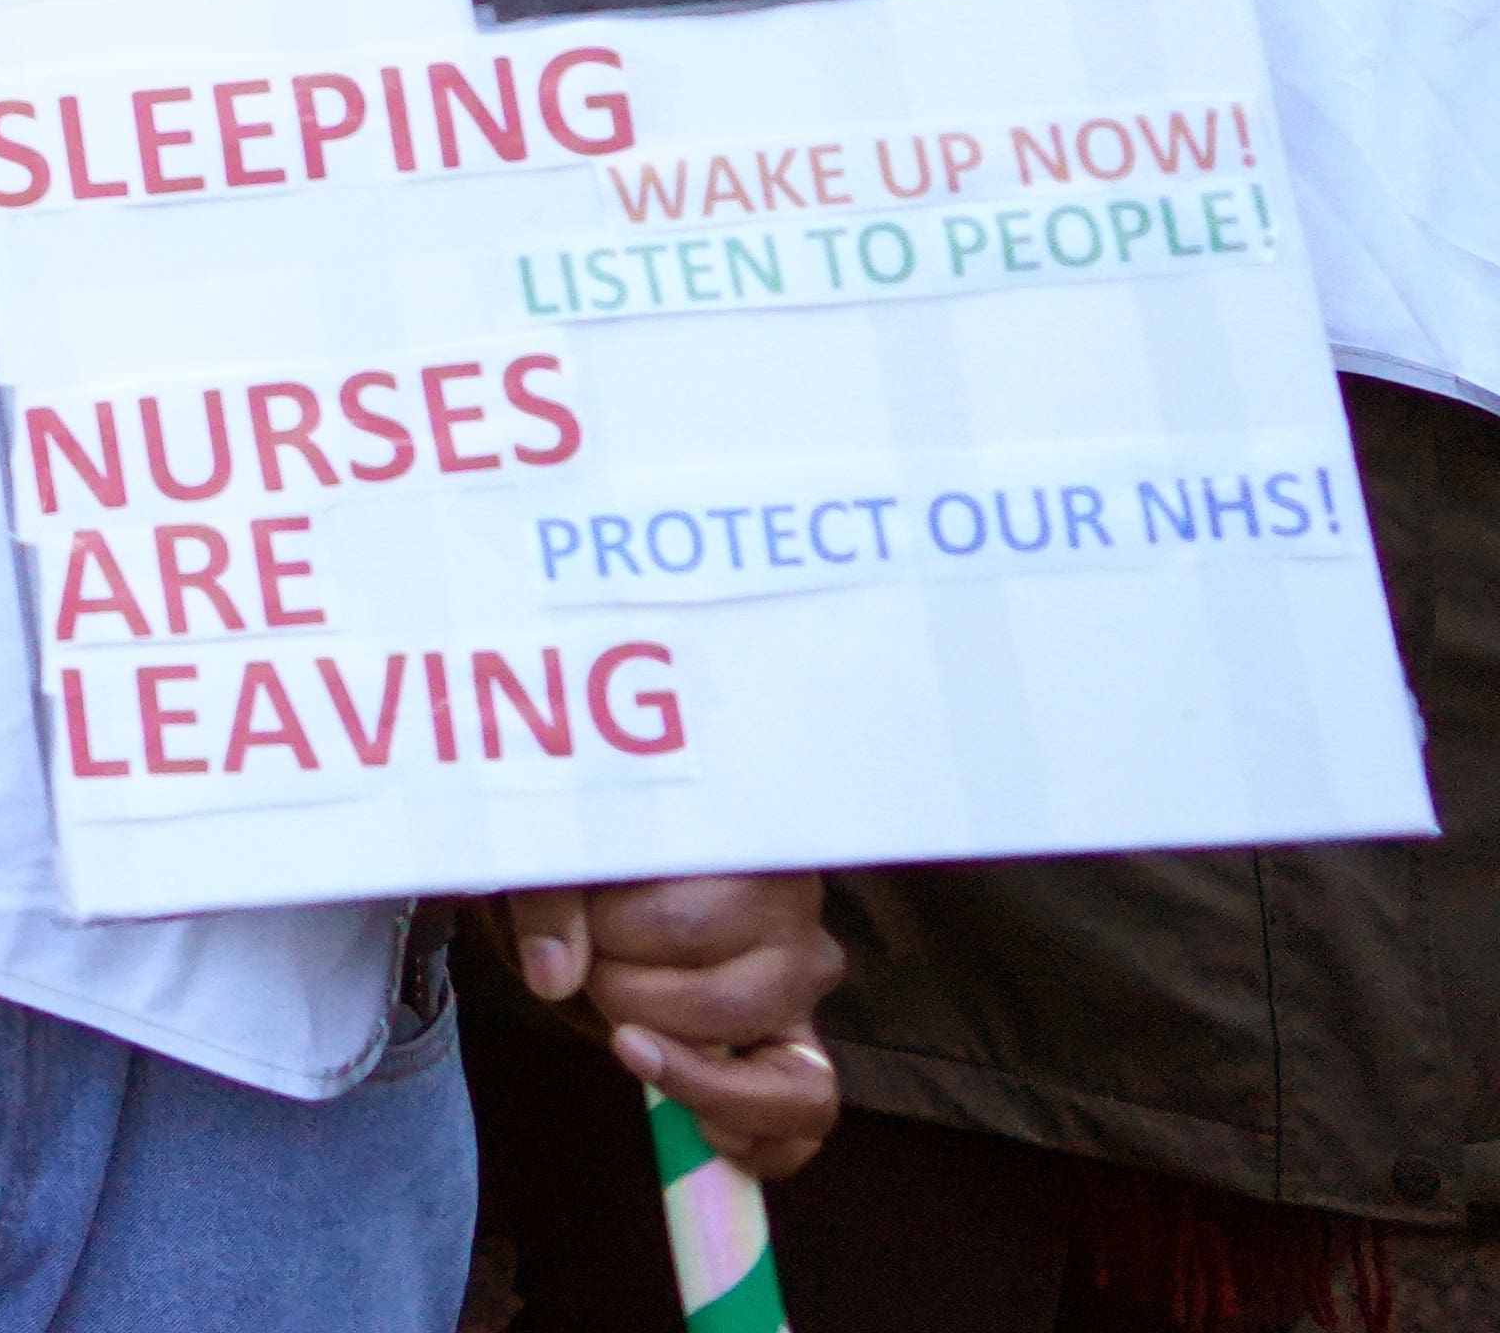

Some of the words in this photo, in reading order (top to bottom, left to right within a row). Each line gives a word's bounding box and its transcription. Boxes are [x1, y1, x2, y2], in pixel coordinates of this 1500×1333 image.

[605, 141, 856, 226] WAKE
[876, 131, 994, 201] UP
[1010, 102, 1258, 186] NOW!
[518, 235, 785, 321] LISTEN
[805, 220, 915, 291] TO
[945, 183, 1278, 281] PEOPLE!
[23, 352, 584, 517] NURSES
[54, 514, 328, 643] ARE
[535, 493, 903, 583] PROTECT
[925, 483, 1115, 558] OUR
[1138, 464, 1344, 546] NHS!
[59, 639, 688, 782] LEAVING
